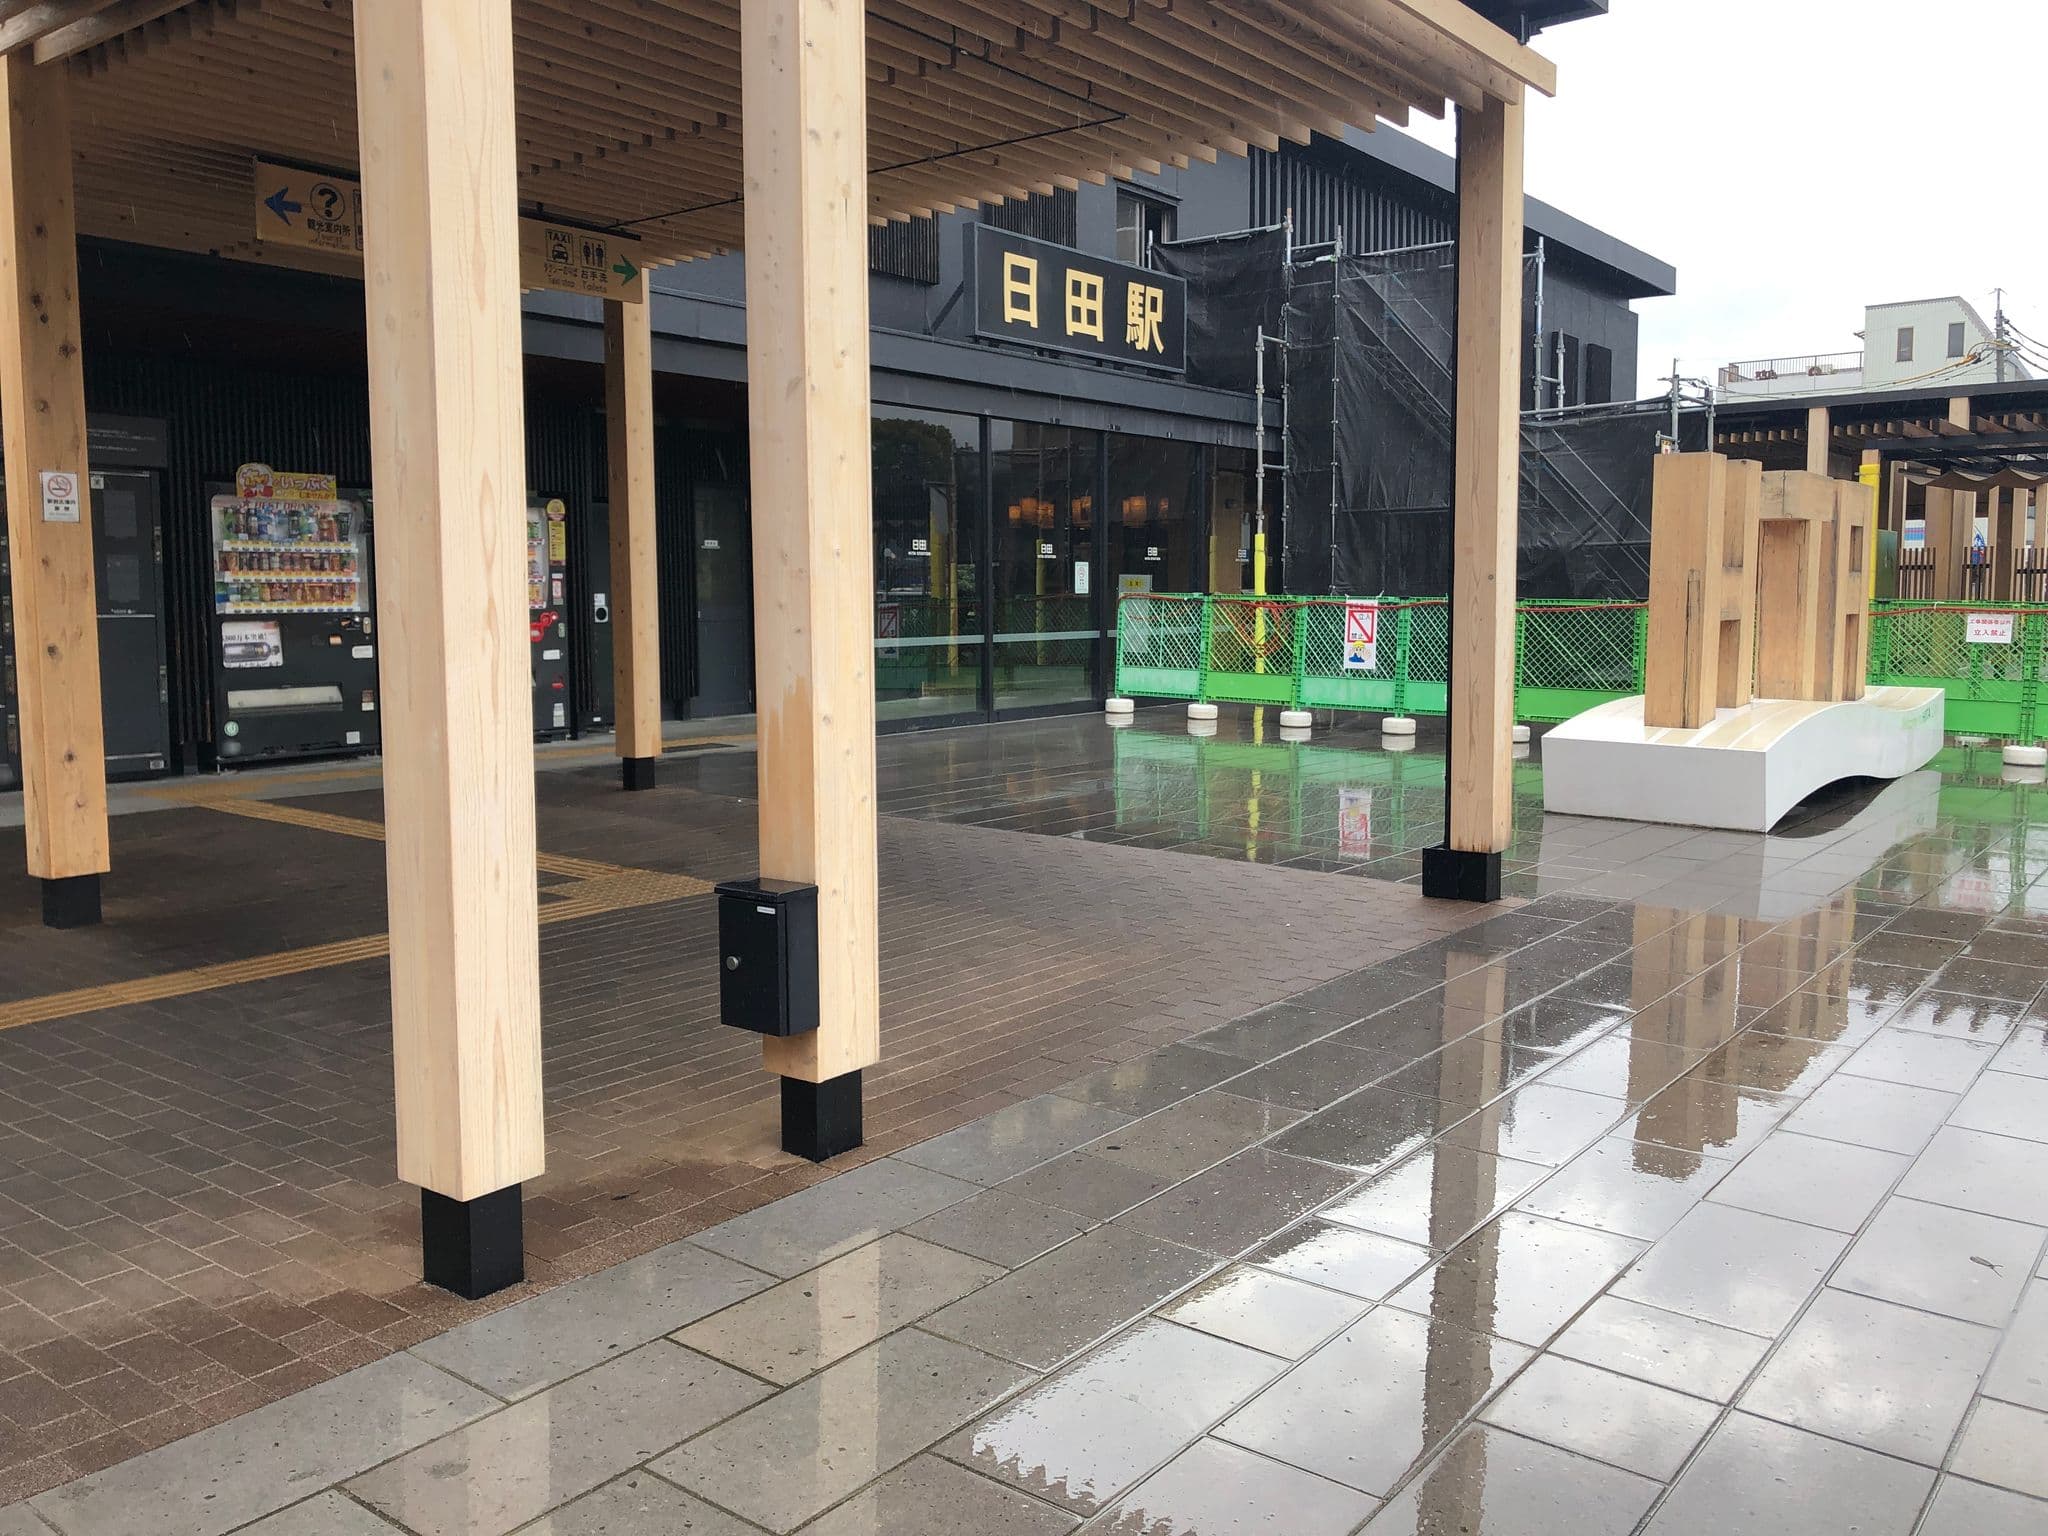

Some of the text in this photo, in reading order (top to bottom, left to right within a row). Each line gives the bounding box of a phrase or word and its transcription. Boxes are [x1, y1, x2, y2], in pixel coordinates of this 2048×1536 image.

[548, 231, 570, 244] TAXI
[1003, 251, 1164, 354] 日田駅
[1973, 629, 2007, 637] 立入禁止
